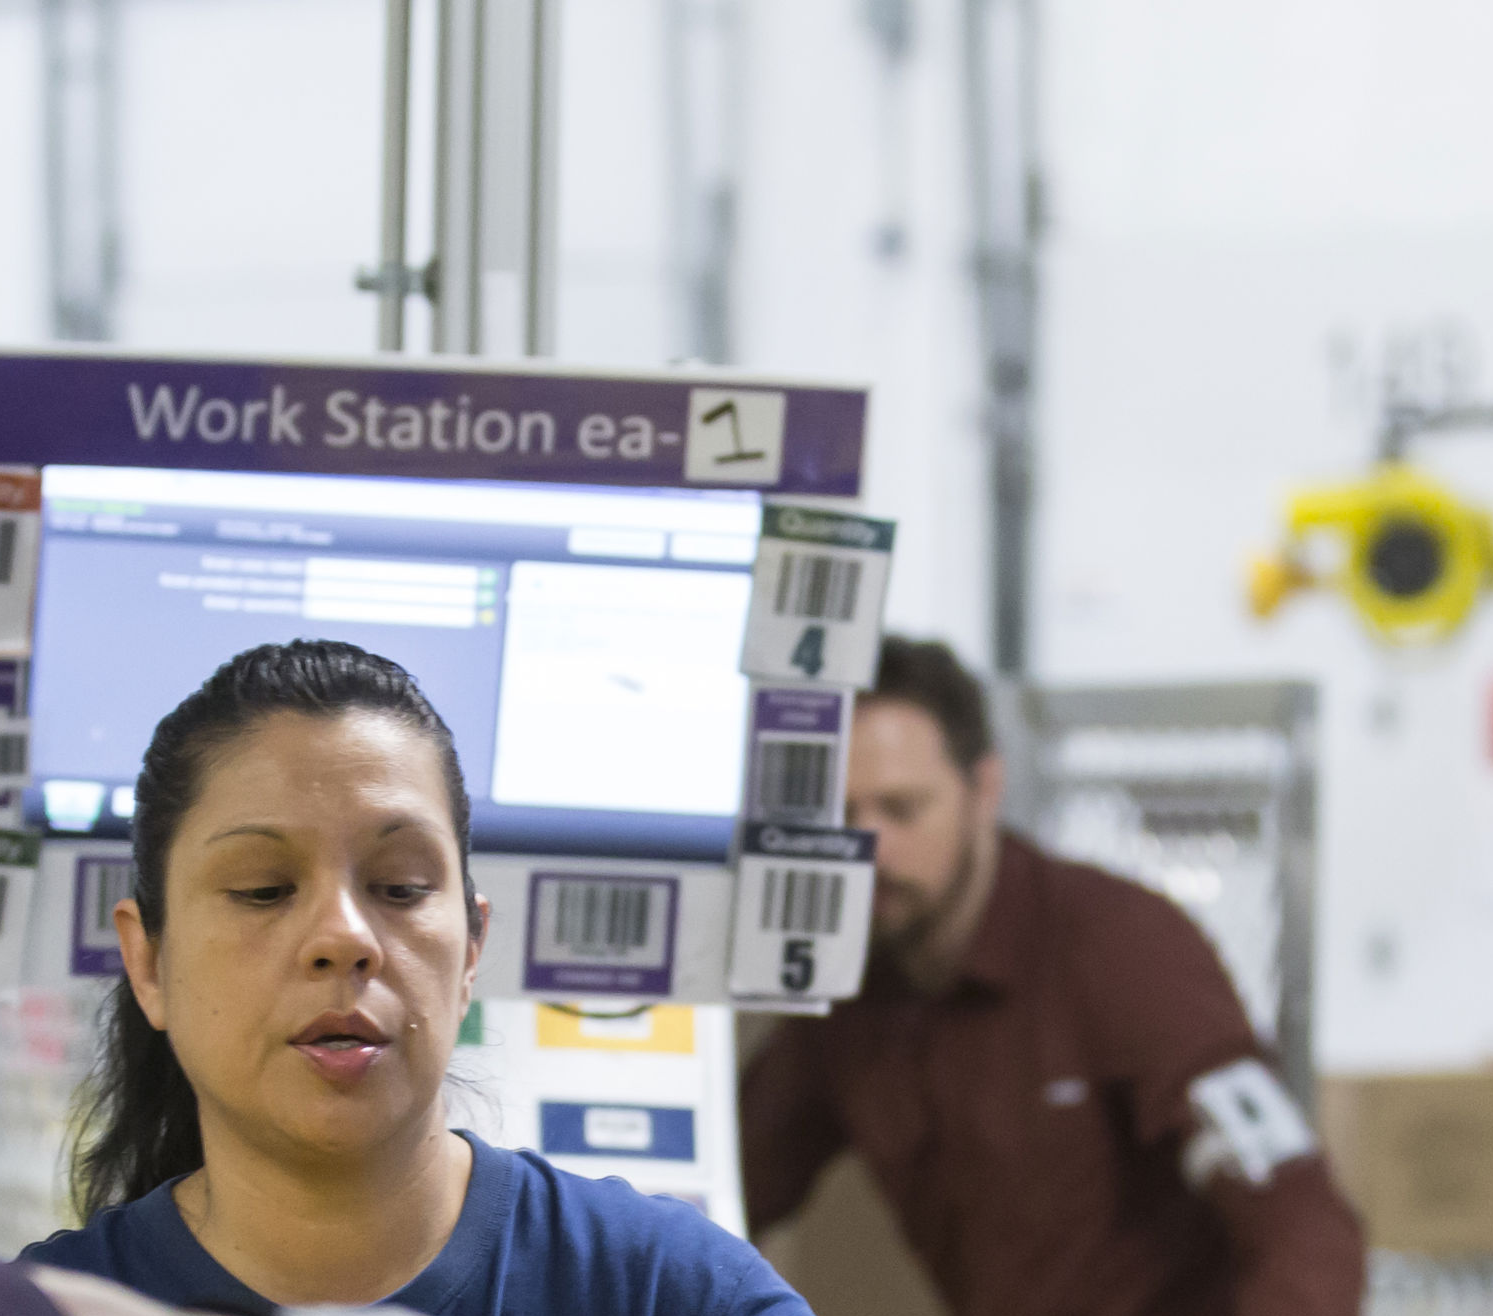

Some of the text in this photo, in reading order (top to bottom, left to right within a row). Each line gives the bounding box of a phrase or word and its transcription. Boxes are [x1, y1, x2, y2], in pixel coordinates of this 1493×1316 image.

[126, 383, 304, 444] Work
[324, 390, 555, 457] Station
[788, 625, 827, 678] 4
[780, 937, 816, 992] 5
